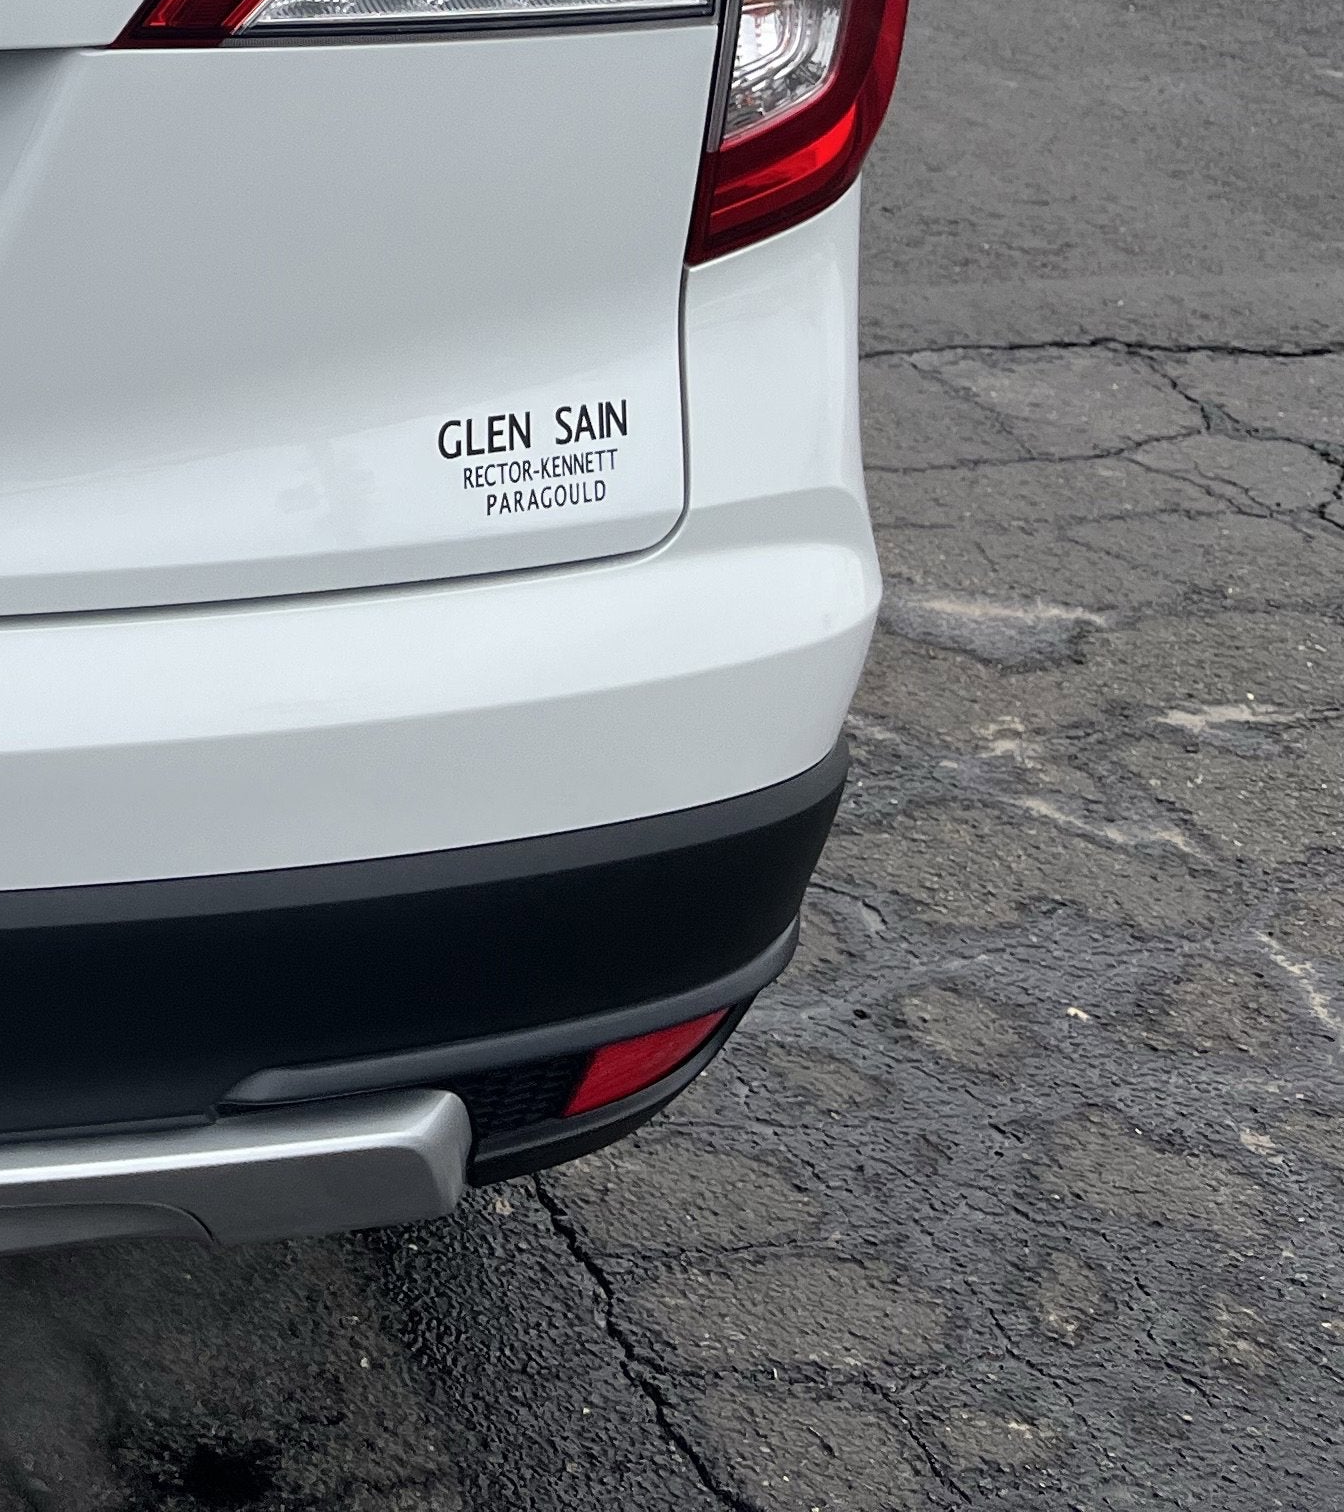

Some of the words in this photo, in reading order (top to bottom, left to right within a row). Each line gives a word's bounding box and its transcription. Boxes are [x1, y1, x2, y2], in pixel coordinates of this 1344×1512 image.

[438, 411, 531, 460] GLEN
[555, 399, 628, 445] SAIN
[463, 448, 618, 489] RECTOR-KENNETT
[486, 480, 607, 516] PARAGOULD
